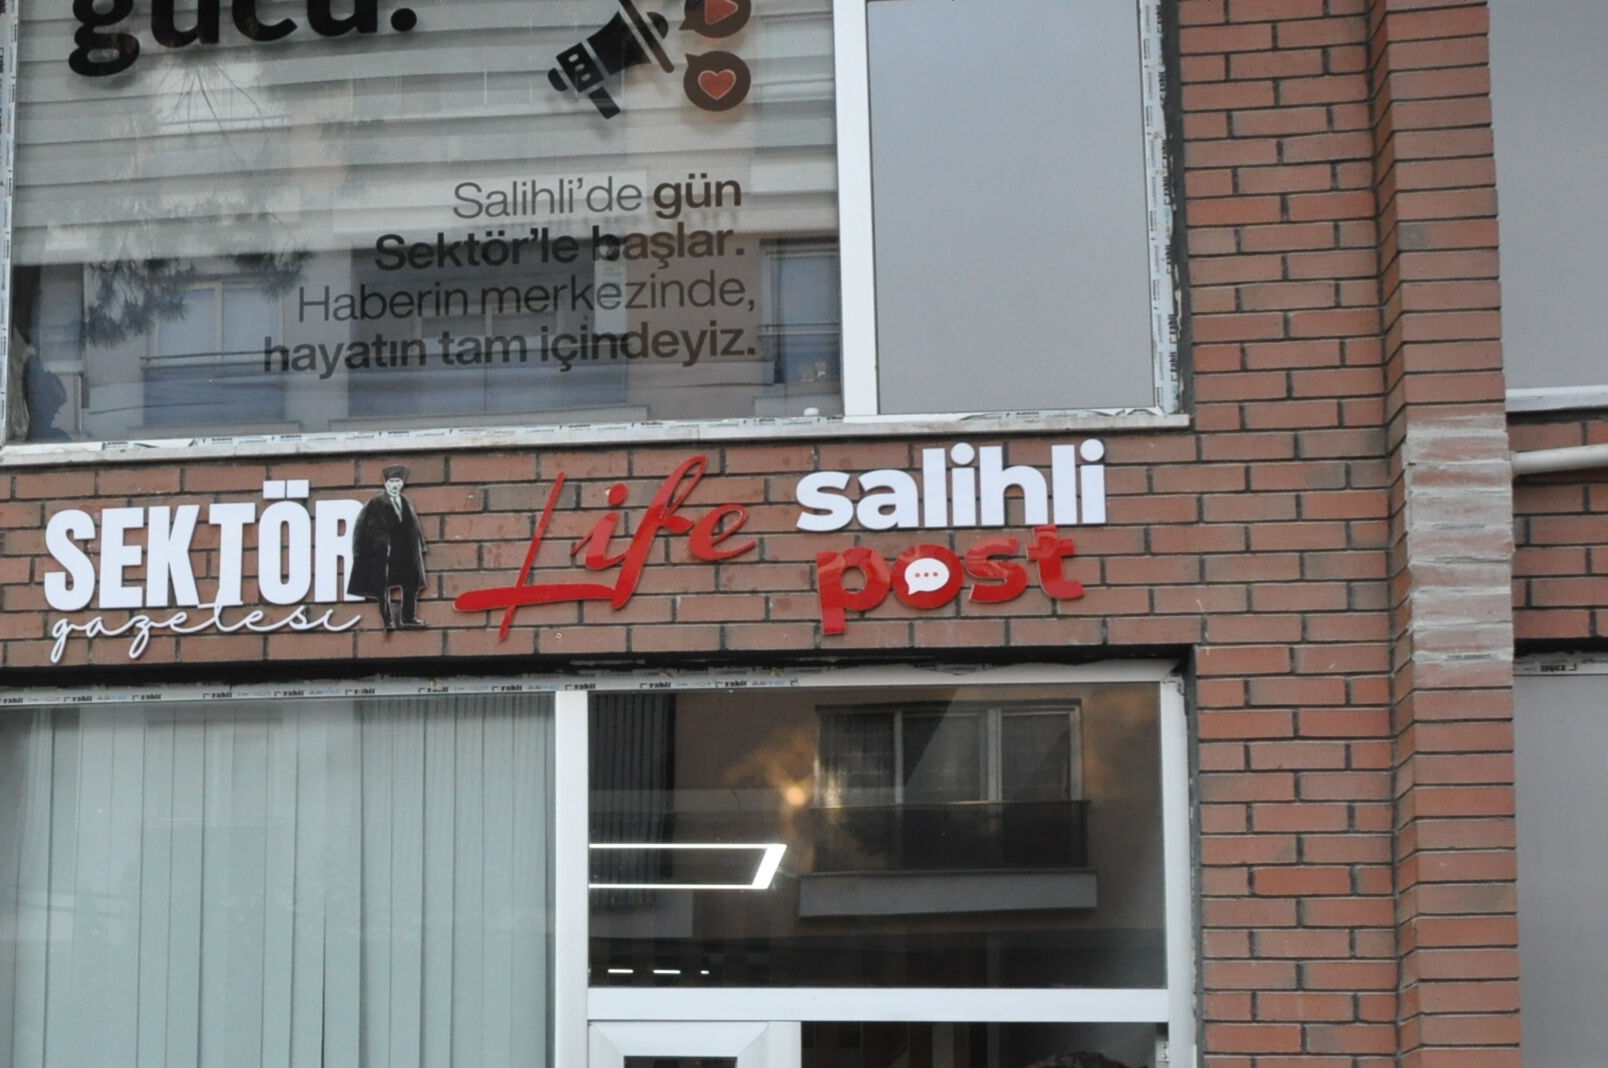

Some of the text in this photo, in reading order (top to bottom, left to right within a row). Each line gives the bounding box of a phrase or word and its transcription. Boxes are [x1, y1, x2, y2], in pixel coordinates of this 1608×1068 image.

[653, 173, 742, 219] gün
[592, 221, 745, 270] başlar.
[299, 269, 755, 322] Haberin merkezinde,
[263, 320, 756, 380] hayatın tam içindeyiz.
[796, 438, 1106, 532] salihli
[44, 479, 366, 611] SEKTÖR
[453, 455, 756, 641] Life
[816, 525, 1085, 636] post
